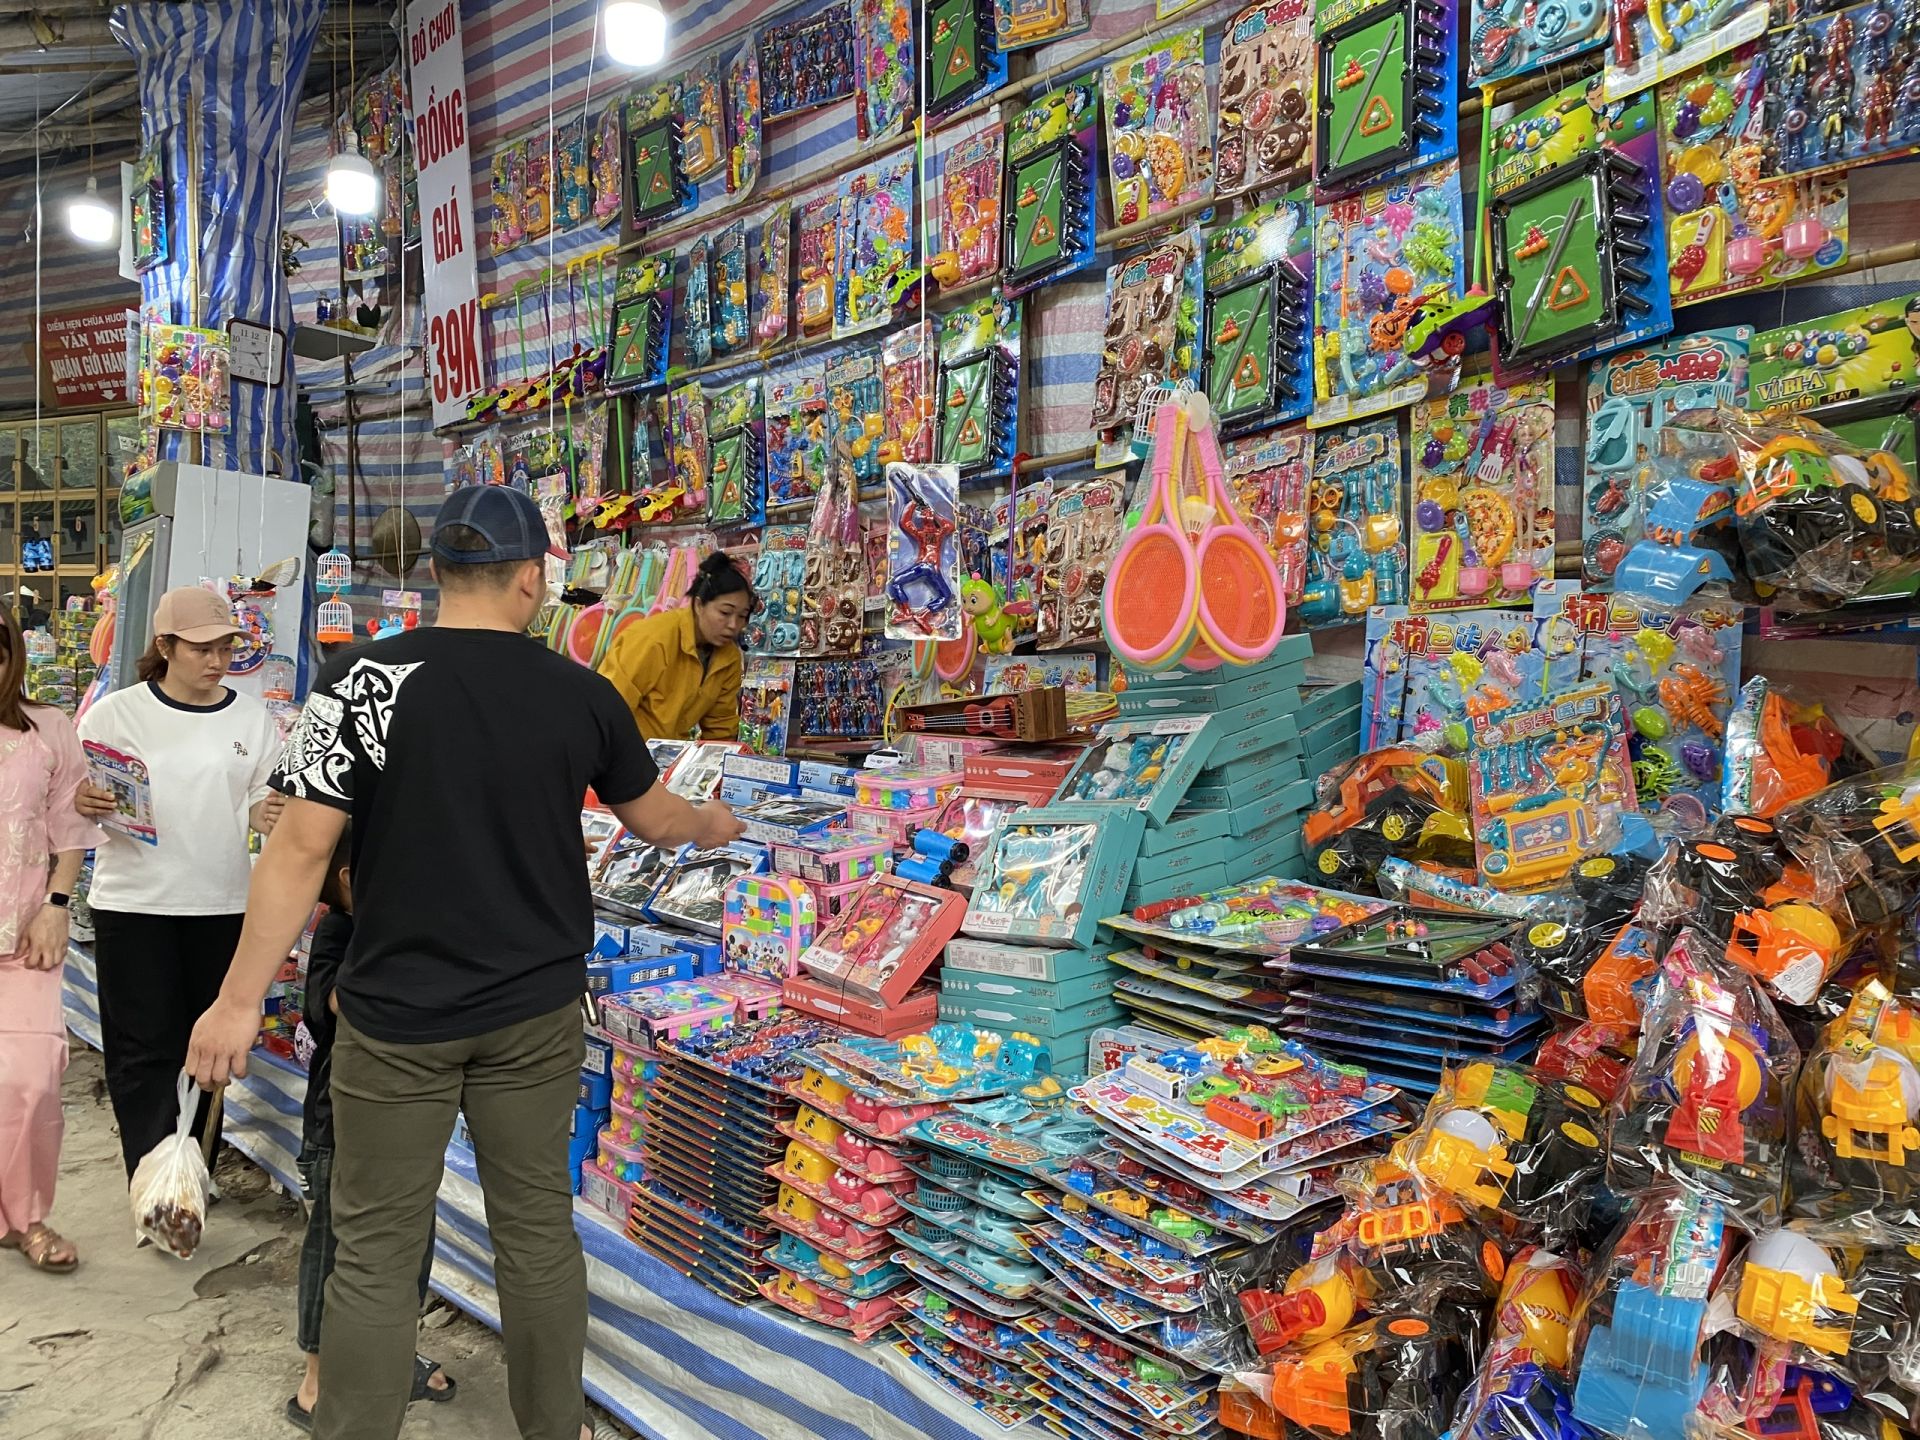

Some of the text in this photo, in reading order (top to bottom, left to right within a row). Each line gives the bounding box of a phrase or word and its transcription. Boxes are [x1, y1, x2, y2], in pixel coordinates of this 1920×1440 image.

[411, 2, 455, 66] ĐỒ CHƠI
[416, 84, 465, 172] ĐỒNG
[432, 185, 463, 265] GIÁ
[60, 328, 127, 349] VĂN MINH
[82, 314, 105, 327] CHÙA
[50, 347, 127, 382] NHẬN GỬI HÀN
[431, 298, 481, 404] 39K
[1757, 371, 1824, 400] VÍ BI-A
[1826, 390, 1852, 403] PLAY
[1391, 615, 1503, 664] 捕鱼达人
